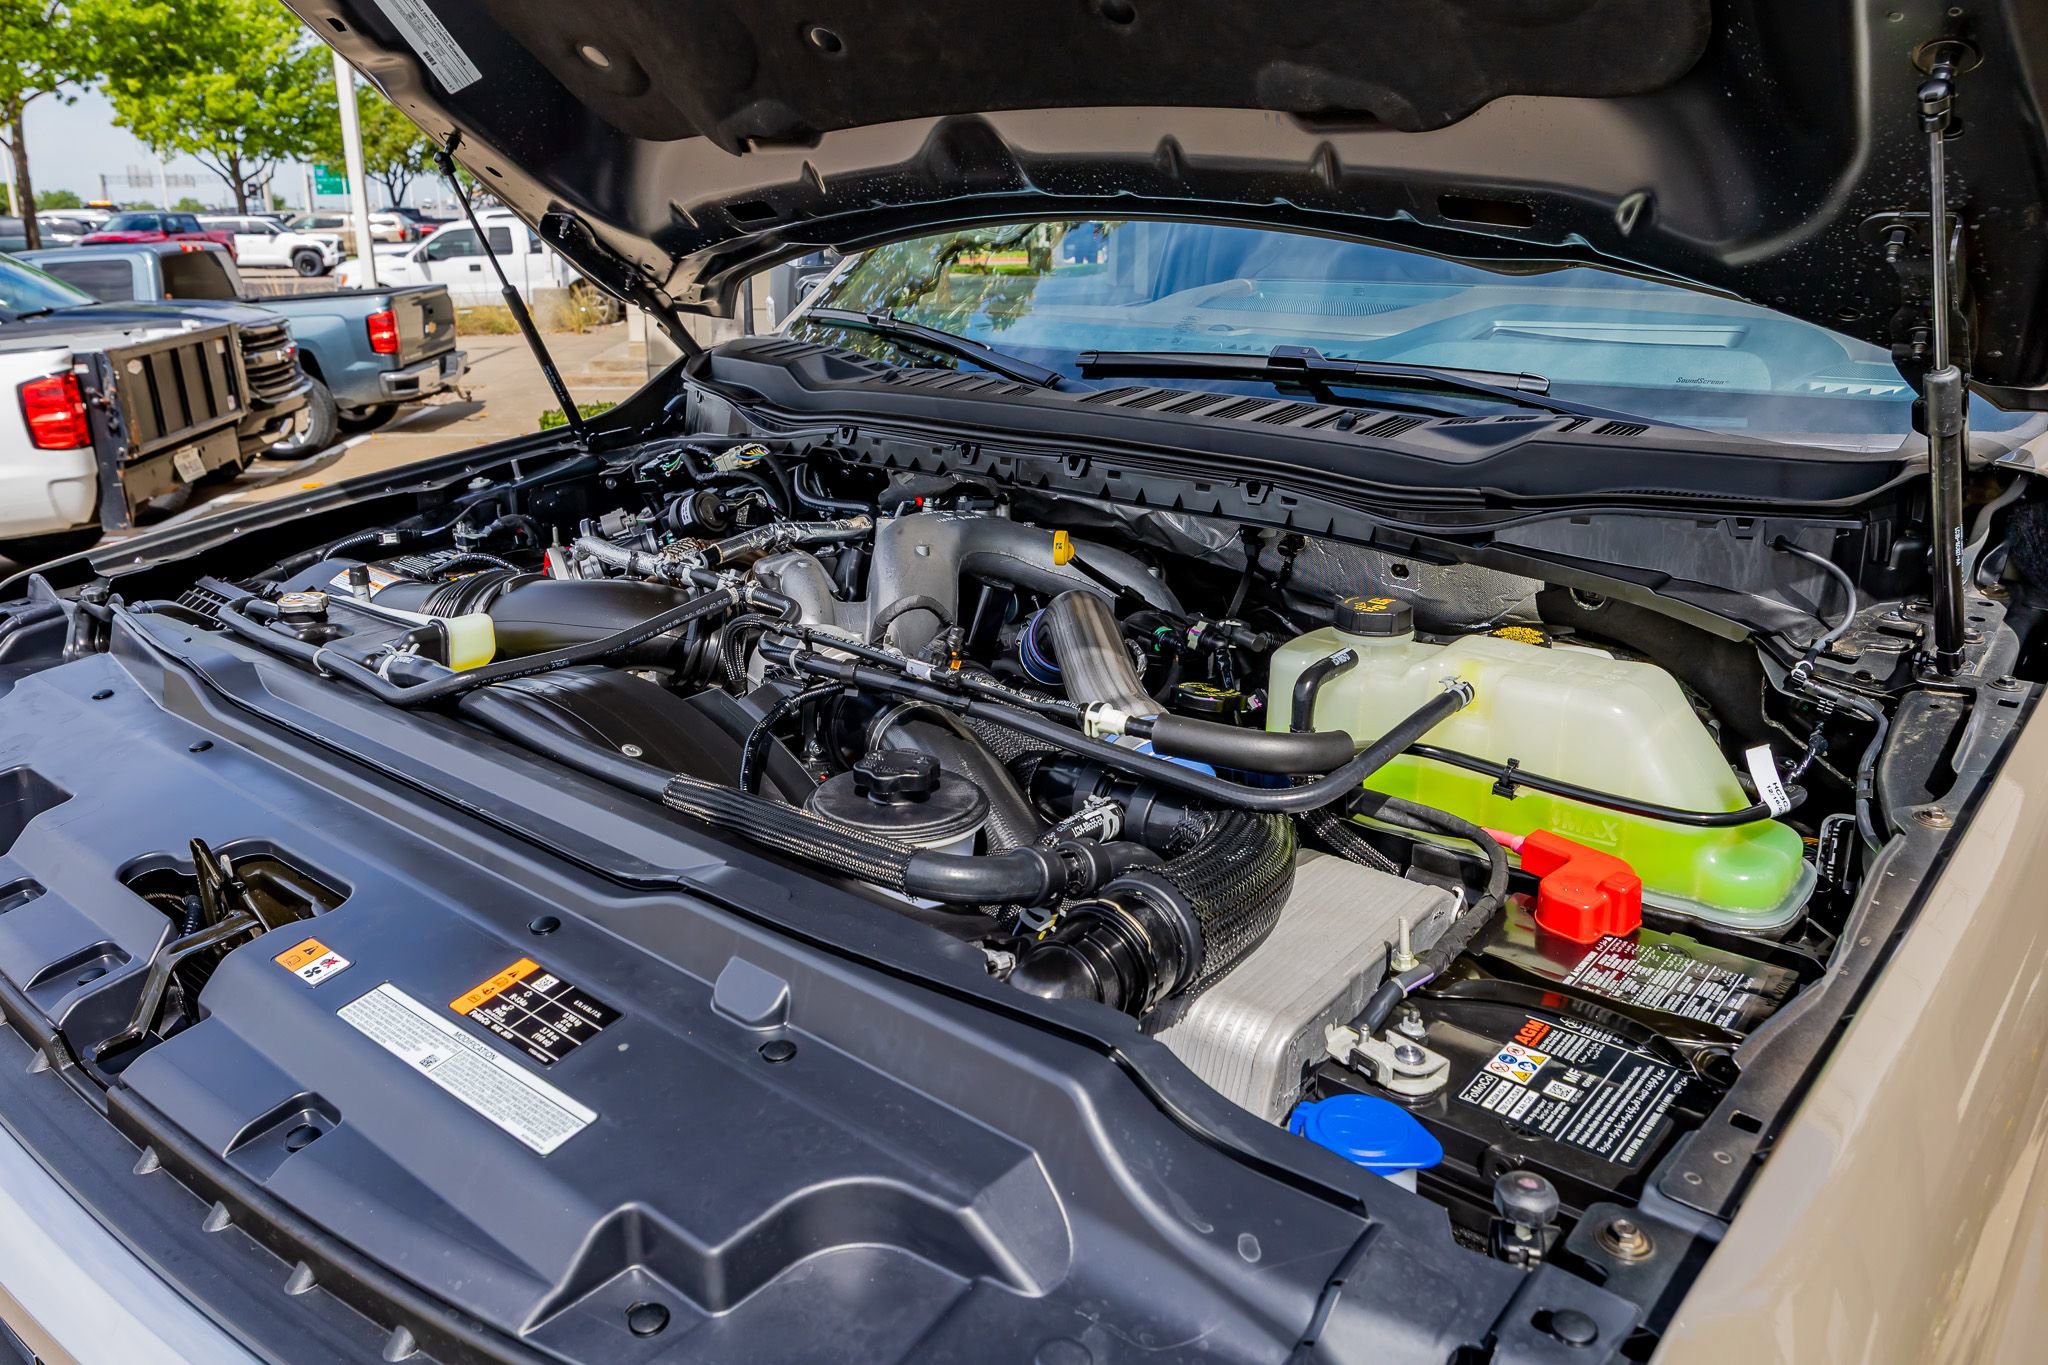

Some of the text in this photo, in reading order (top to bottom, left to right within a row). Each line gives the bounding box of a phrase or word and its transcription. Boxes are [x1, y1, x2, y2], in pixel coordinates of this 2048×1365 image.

[453, 1031, 498, 1061] MODIFICATION
[1514, 1020, 1545, 1046] AGM
[1464, 1075, 1494, 1102] FoMoCo
[1562, 1067, 1582, 1084] MF
